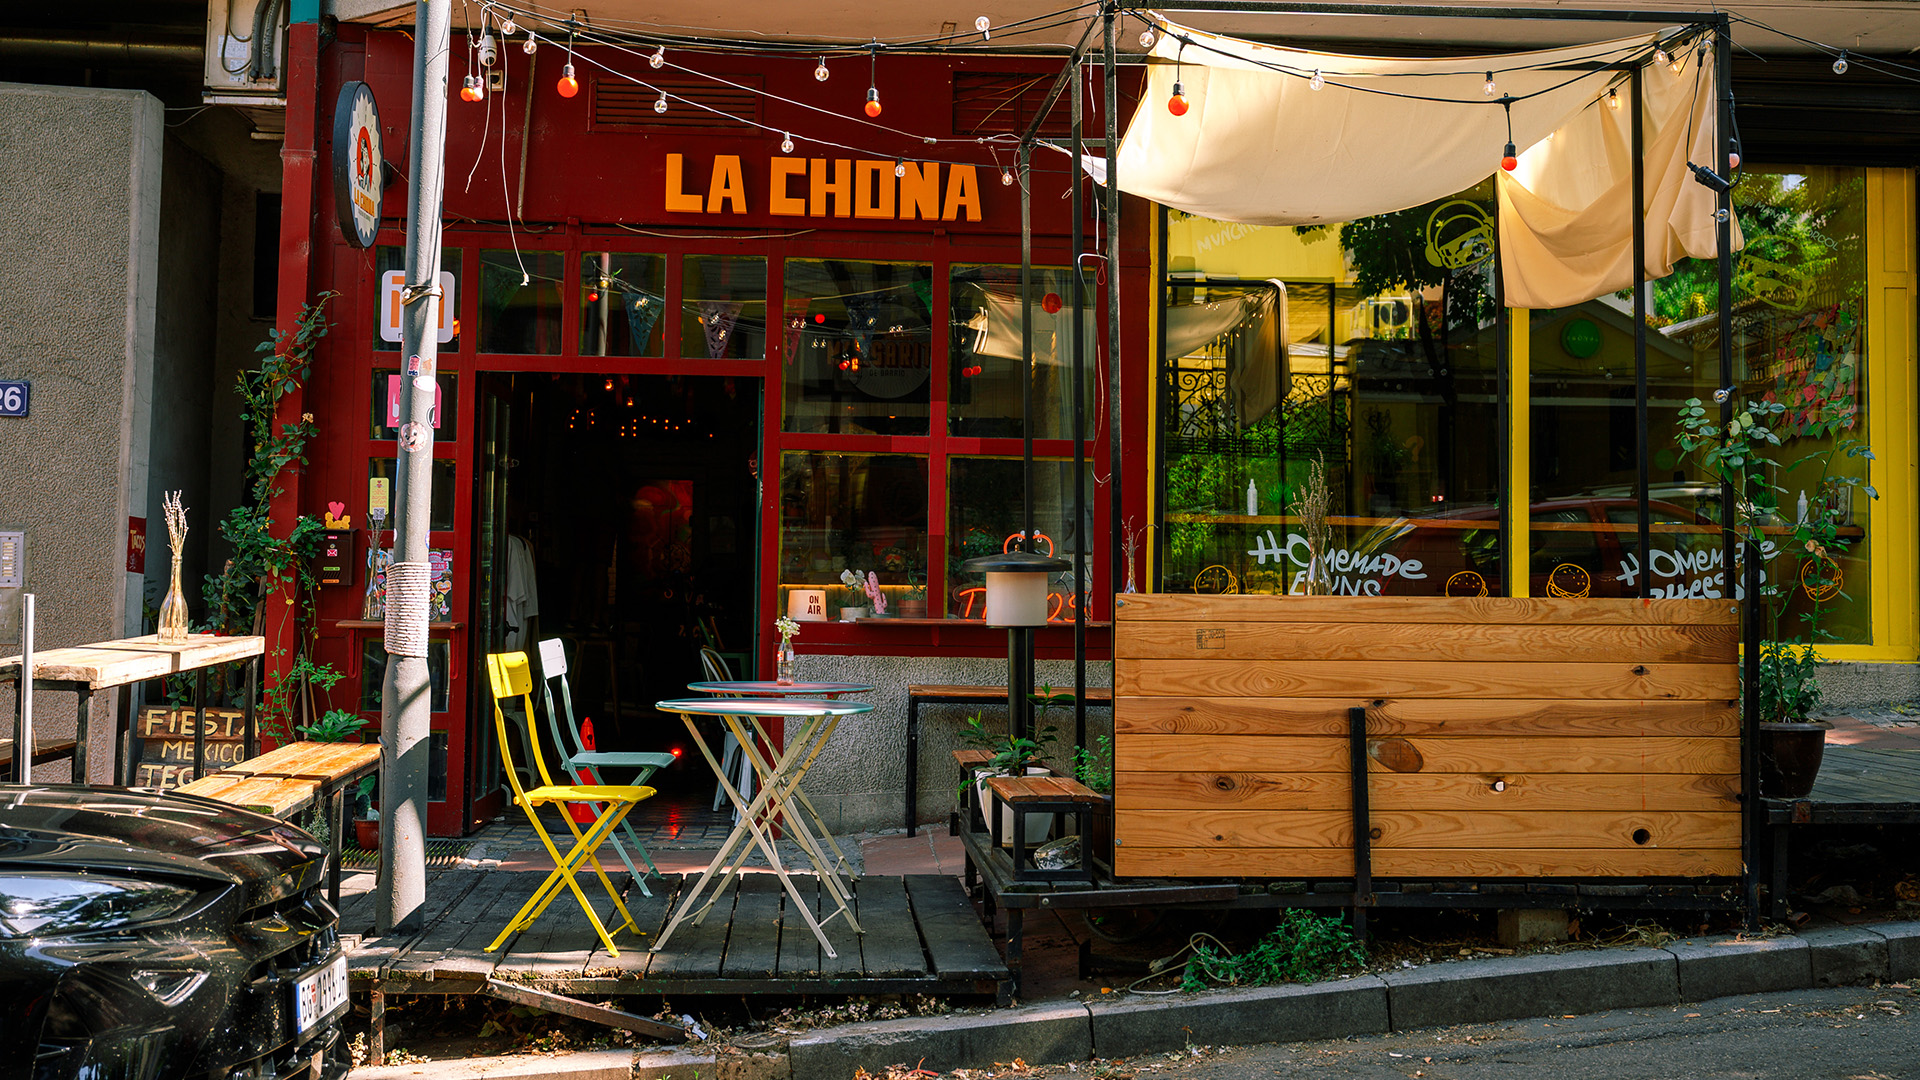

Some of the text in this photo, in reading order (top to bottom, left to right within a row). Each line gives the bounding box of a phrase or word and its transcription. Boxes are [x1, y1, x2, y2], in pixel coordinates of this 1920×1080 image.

[666, 153, 982, 222] LA CHONA
[0, 386, 21, 411] 6
[809, 595, 820, 604] ON
[807, 604, 822, 615] AIR
